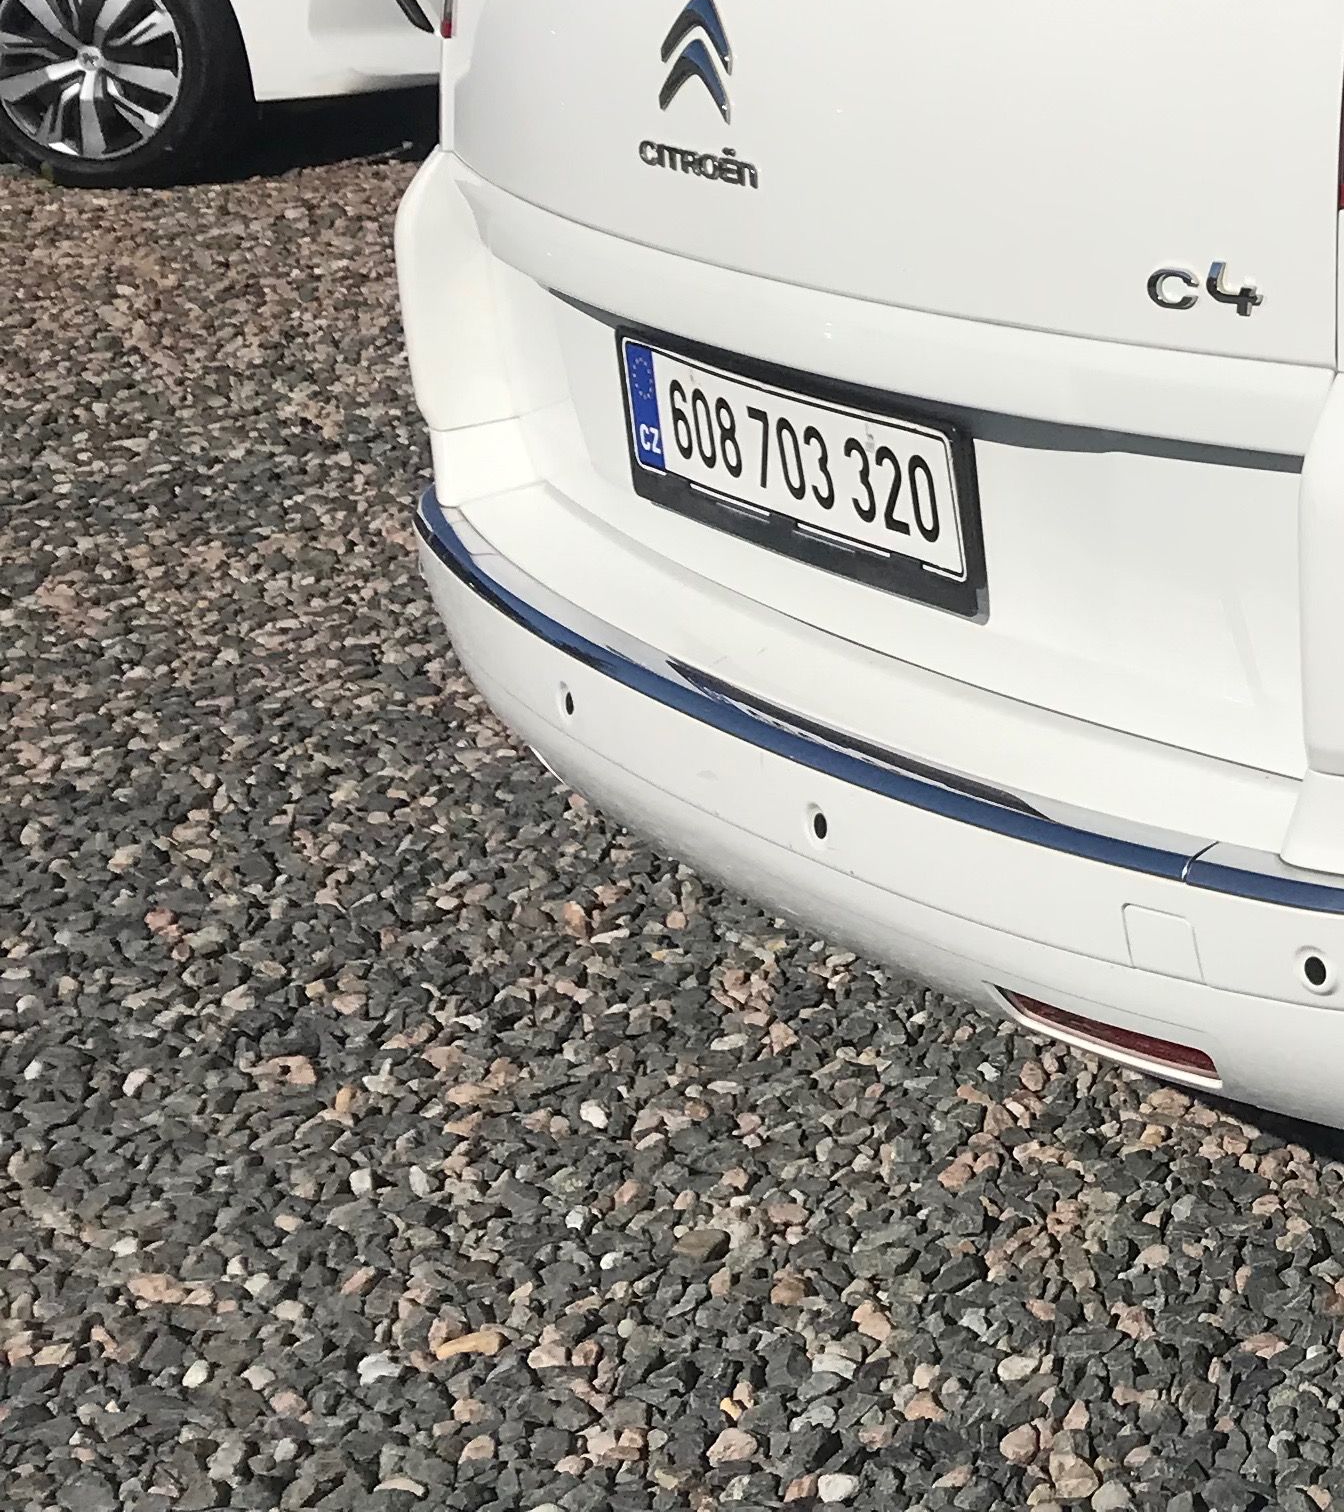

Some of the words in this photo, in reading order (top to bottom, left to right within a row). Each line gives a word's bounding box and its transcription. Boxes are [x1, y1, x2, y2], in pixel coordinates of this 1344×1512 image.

[1146, 260, 1264, 318] C4
[638, 422, 663, 455] CZ
[669, 379, 743, 479] 608
[746, 405, 835, 511] 703
[843, 437, 940, 544] 320
